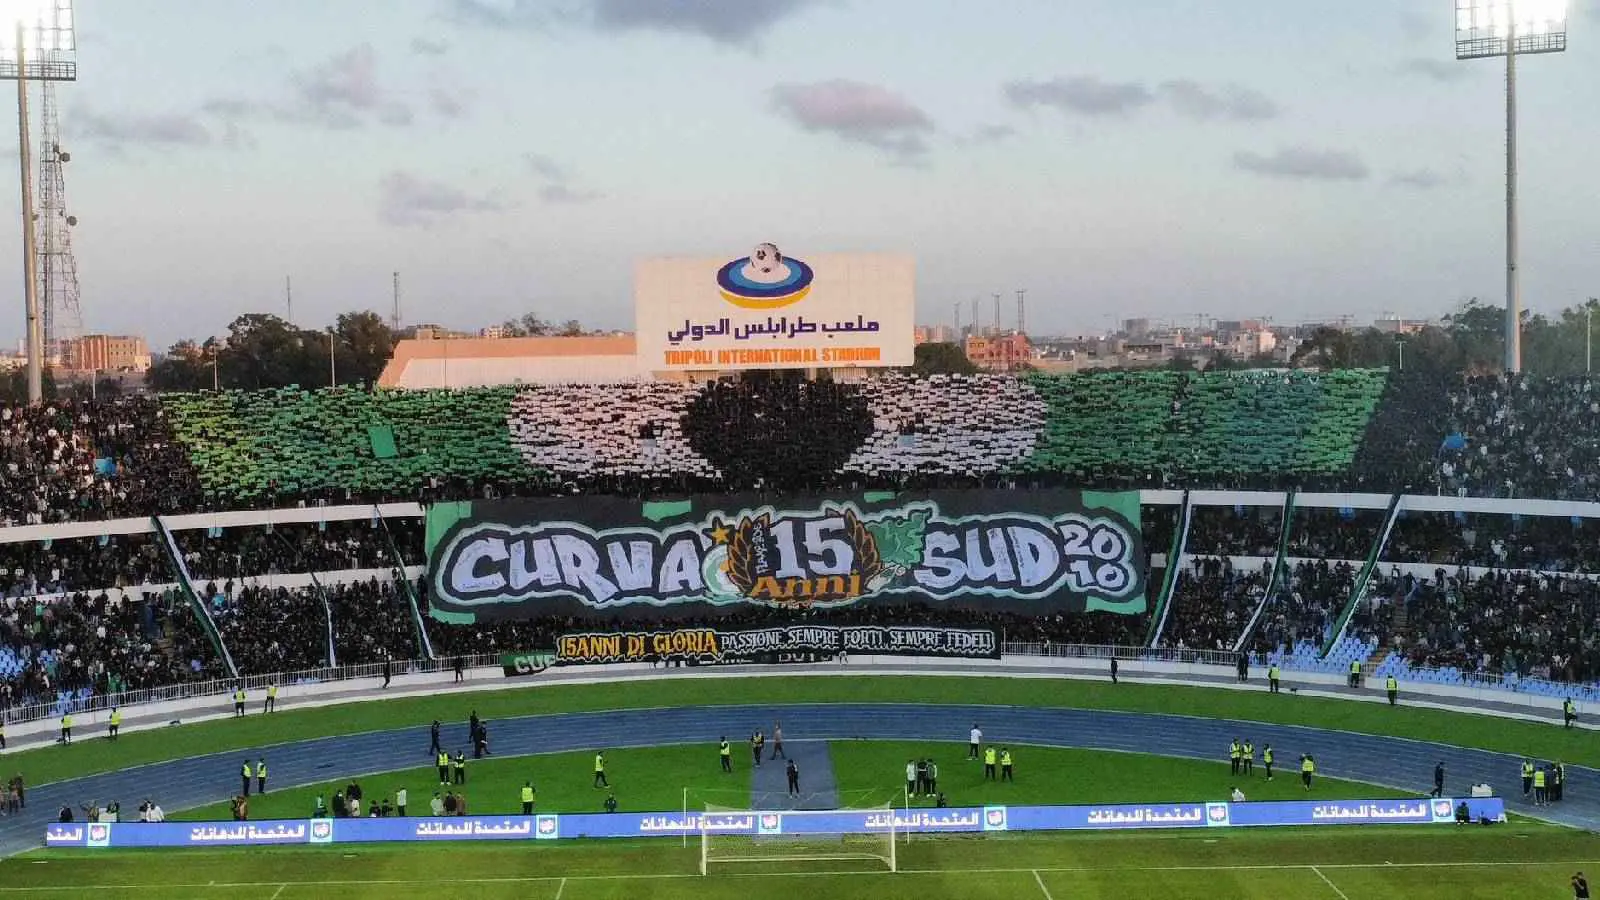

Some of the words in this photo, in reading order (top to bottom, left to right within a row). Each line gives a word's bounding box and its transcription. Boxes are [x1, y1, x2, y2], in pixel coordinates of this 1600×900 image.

[667, 318, 730, 345] الدولي
[734, 316, 817, 340] طرابلس
[821, 315, 880, 338] ملعب
[664, 350, 713, 365] TRIPOLI
[718, 347, 817, 364] INTERNATIONAL
[822, 347, 881, 361] STADIUM
[1062, 522, 1122, 559] 20
[450, 534, 706, 601] CURVA
[769, 517, 856, 579] 15
[914, 527, 1060, 589] SUD
[1069, 560, 1126, 588] 10
[751, 568, 861, 599] Anni
[627, 632, 645, 656] DI
[653, 629, 717, 656] GLORIA
[721, 628, 781, 650] PASSIONE
[787, 628, 839, 645] SEMPRE
[843, 630, 882, 646] FORTI
[890, 630, 940, 647] SEMPRE
[946, 631, 994, 651] FEDELI
[1087, 809, 1143, 824] للدهانات
[1145, 808, 1201, 822] المتحدة
[1312, 804, 1368, 818] للدهانات
[1370, 803, 1426, 818] المتحدة
[698, 815, 752, 830] المتحدة
[922, 812, 979, 826] المتحدة
[191, 826, 246, 840] للدهانات
[248, 824, 304, 839] المتحدة
[416, 821, 472, 835] للدهانات
[474, 820, 530, 834] المتحدة
